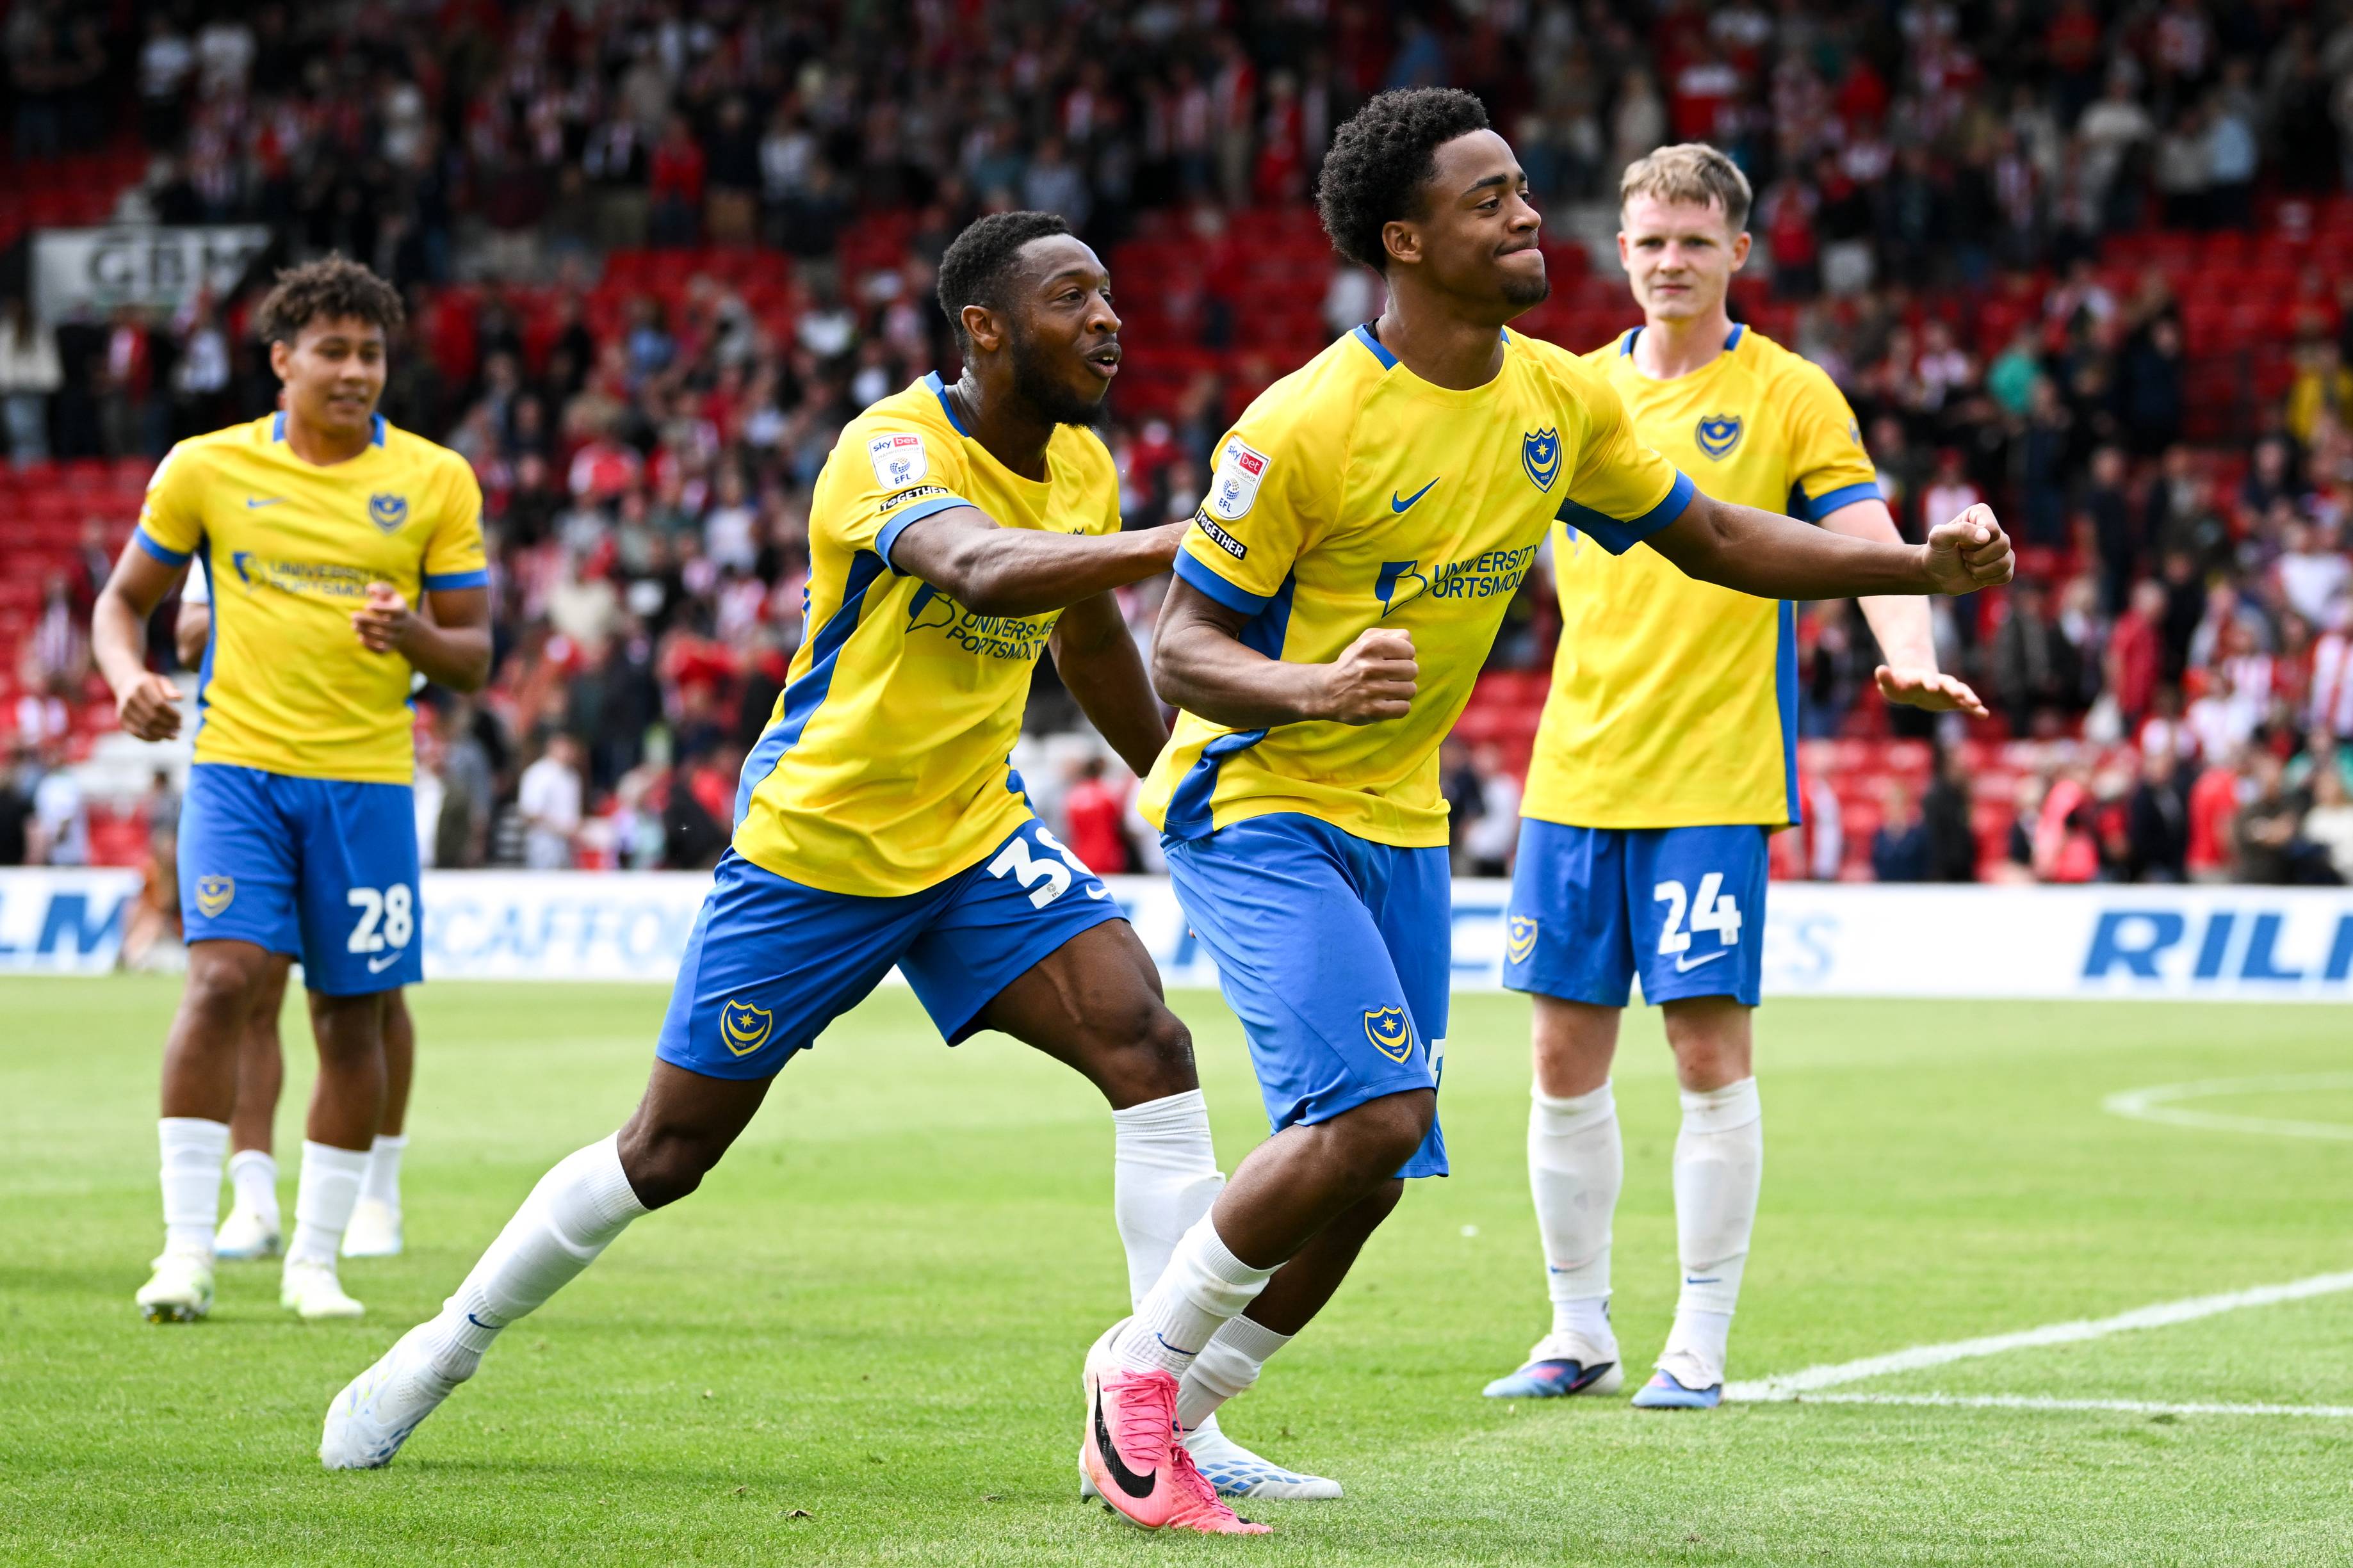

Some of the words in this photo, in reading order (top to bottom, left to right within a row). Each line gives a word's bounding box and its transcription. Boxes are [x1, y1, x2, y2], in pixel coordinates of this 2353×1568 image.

[873, 440, 891, 451] sky
[895, 437, 916, 446] bet
[1227, 445, 1241, 461] sky
[1241, 455, 1260, 472] bet
[895, 474, 911, 485] EFL
[1219, 499, 1231, 512] EFL
[1197, 510, 1244, 558] TOGETHER
[347, 882, 414, 953] 28
[1654, 872, 1742, 955] 24
[2083, 912, 2353, 979] RIL
